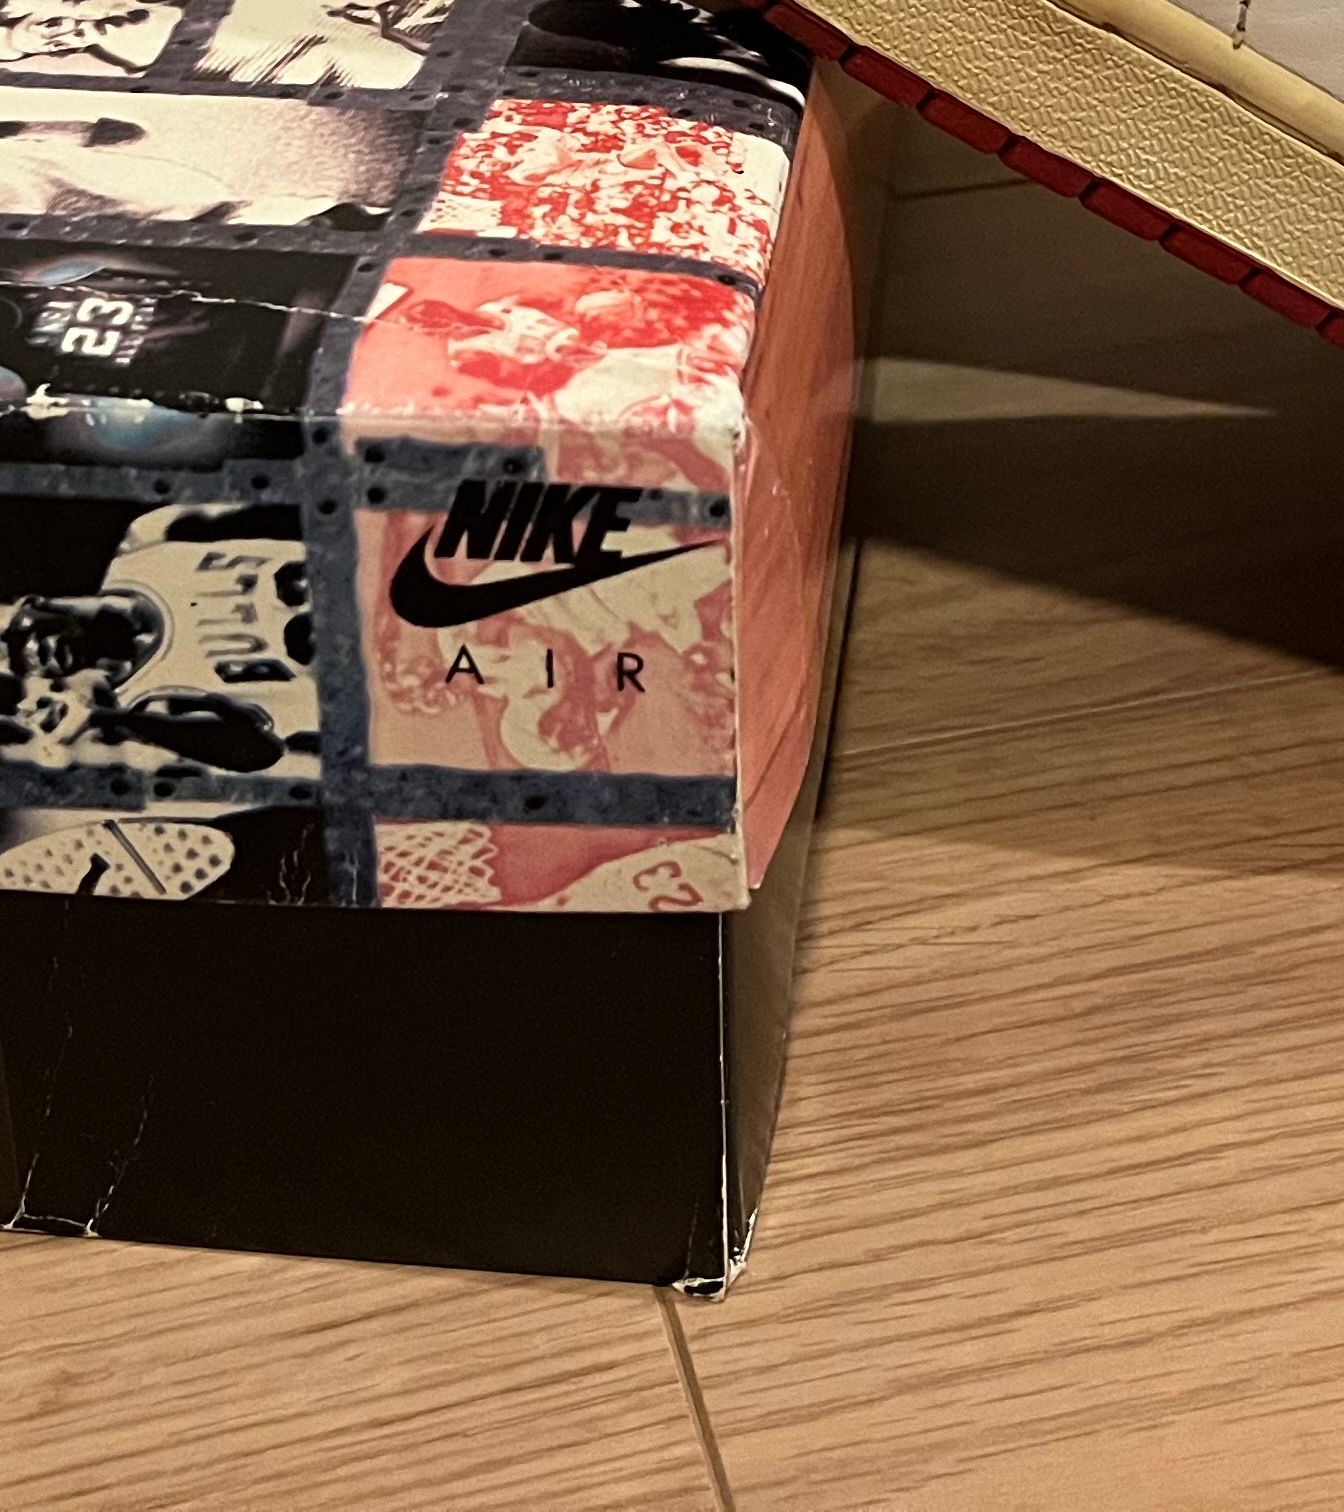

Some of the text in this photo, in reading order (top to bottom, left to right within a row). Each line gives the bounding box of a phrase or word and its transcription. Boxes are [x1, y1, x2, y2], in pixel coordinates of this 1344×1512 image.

[60, 297, 134, 357] 23
[433, 479, 644, 565] NIKE
[445, 644, 646, 693] AIR
